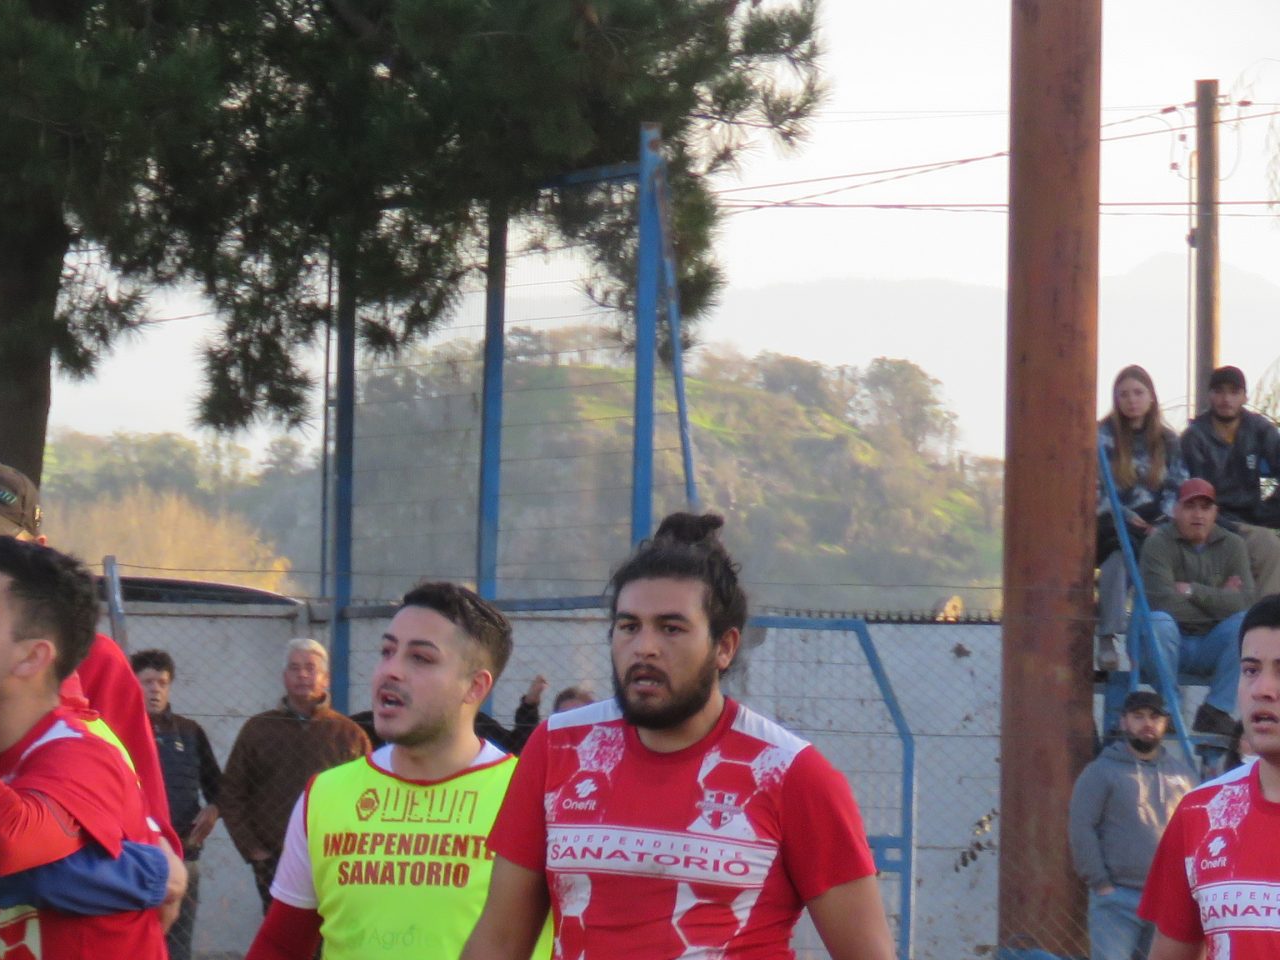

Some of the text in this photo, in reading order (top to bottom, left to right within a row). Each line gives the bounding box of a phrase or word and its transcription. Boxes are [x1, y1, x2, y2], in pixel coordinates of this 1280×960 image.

[562, 798, 597, 811] Onefit
[550, 843, 751, 877] SANATORIO
[555, 834, 743, 860] NDEPENDIENTE
[338, 860, 471, 888] SANATORIO
[1201, 903, 1280, 923] SANAT
